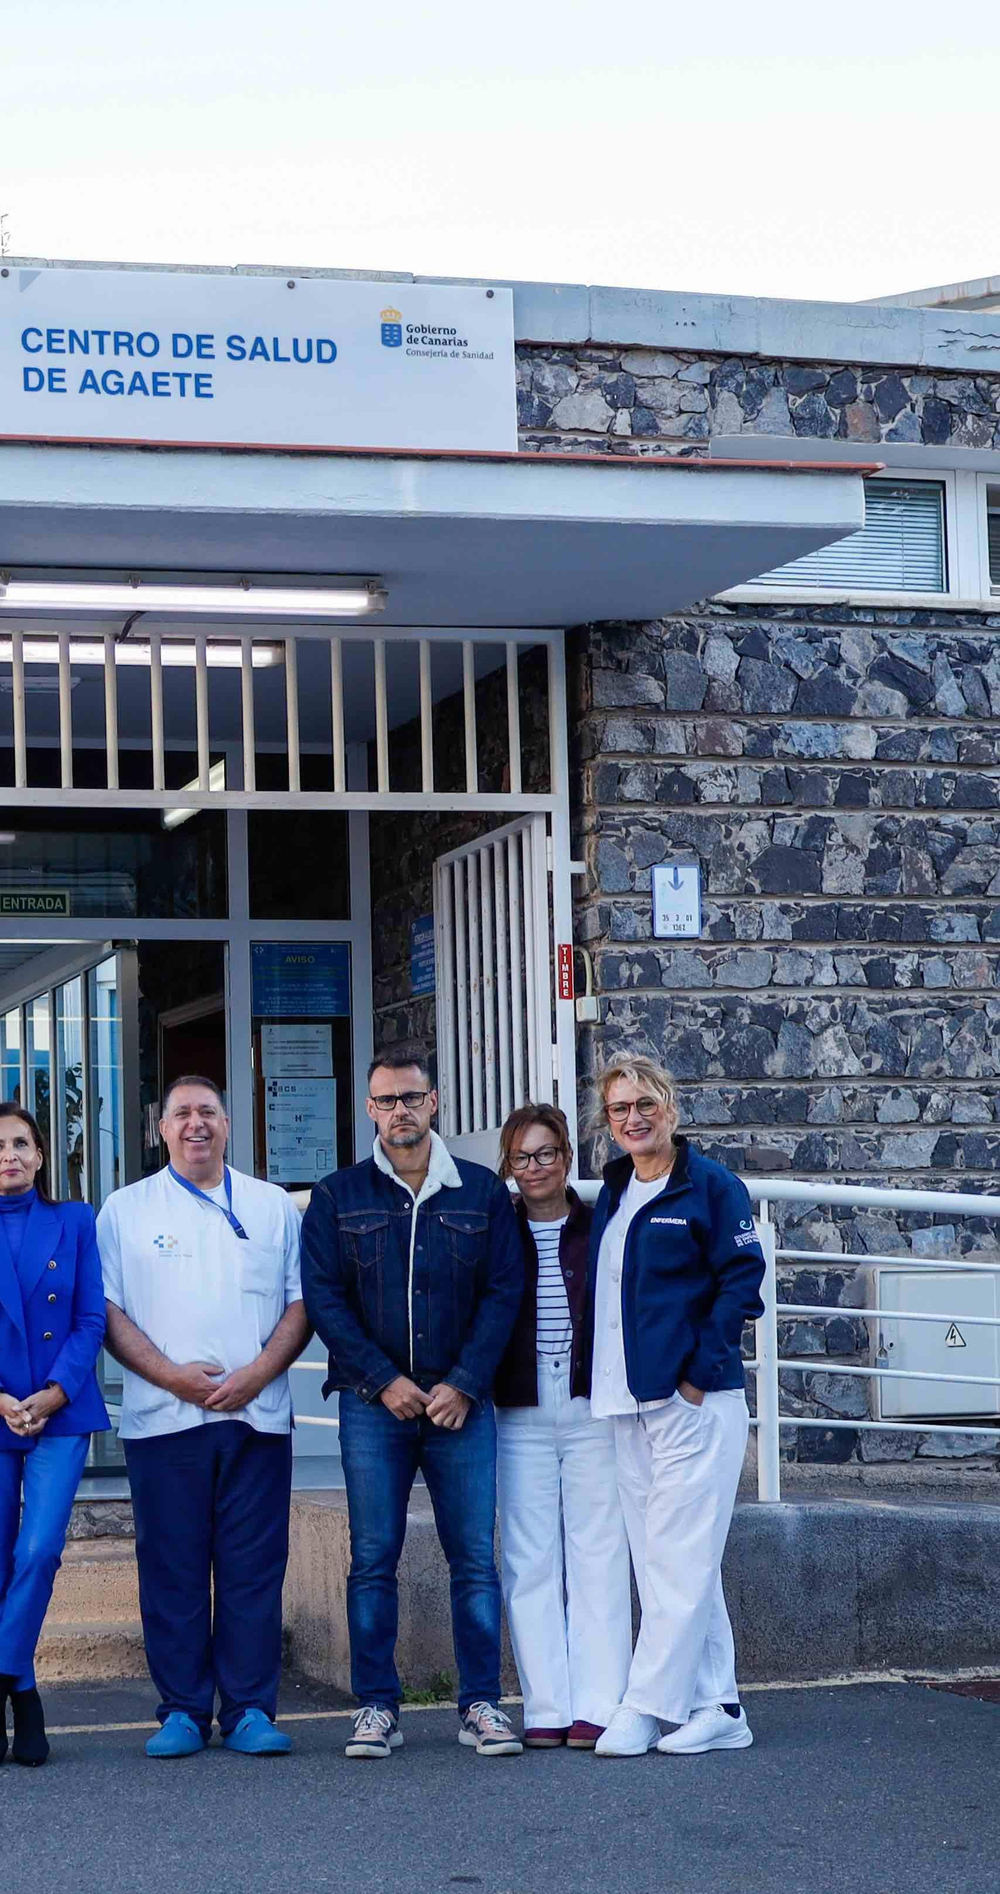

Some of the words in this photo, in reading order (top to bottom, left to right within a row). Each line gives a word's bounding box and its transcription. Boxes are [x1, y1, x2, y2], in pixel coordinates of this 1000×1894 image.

[406, 324, 457, 335] Gobierno
[21, 327, 160, 358] CENTRO
[171, 333, 216, 359] DE
[226, 335, 338, 364] SALUD
[406, 335, 419, 345] de
[421, 336, 468, 347] Canarias
[405, 348, 448, 359] Consejería
[449, 349, 460, 359] de
[462, 350, 495, 360] Sanidad
[23, 367, 68, 394] DE
[78, 369, 215, 399] AGAETE
[2, 897, 64, 910] ENTRADA
[285, 955, 315, 964] AVISO
[561, 947, 569, 996] TIMBRE
[650, 1217, 687, 1226] ENFERMERA
